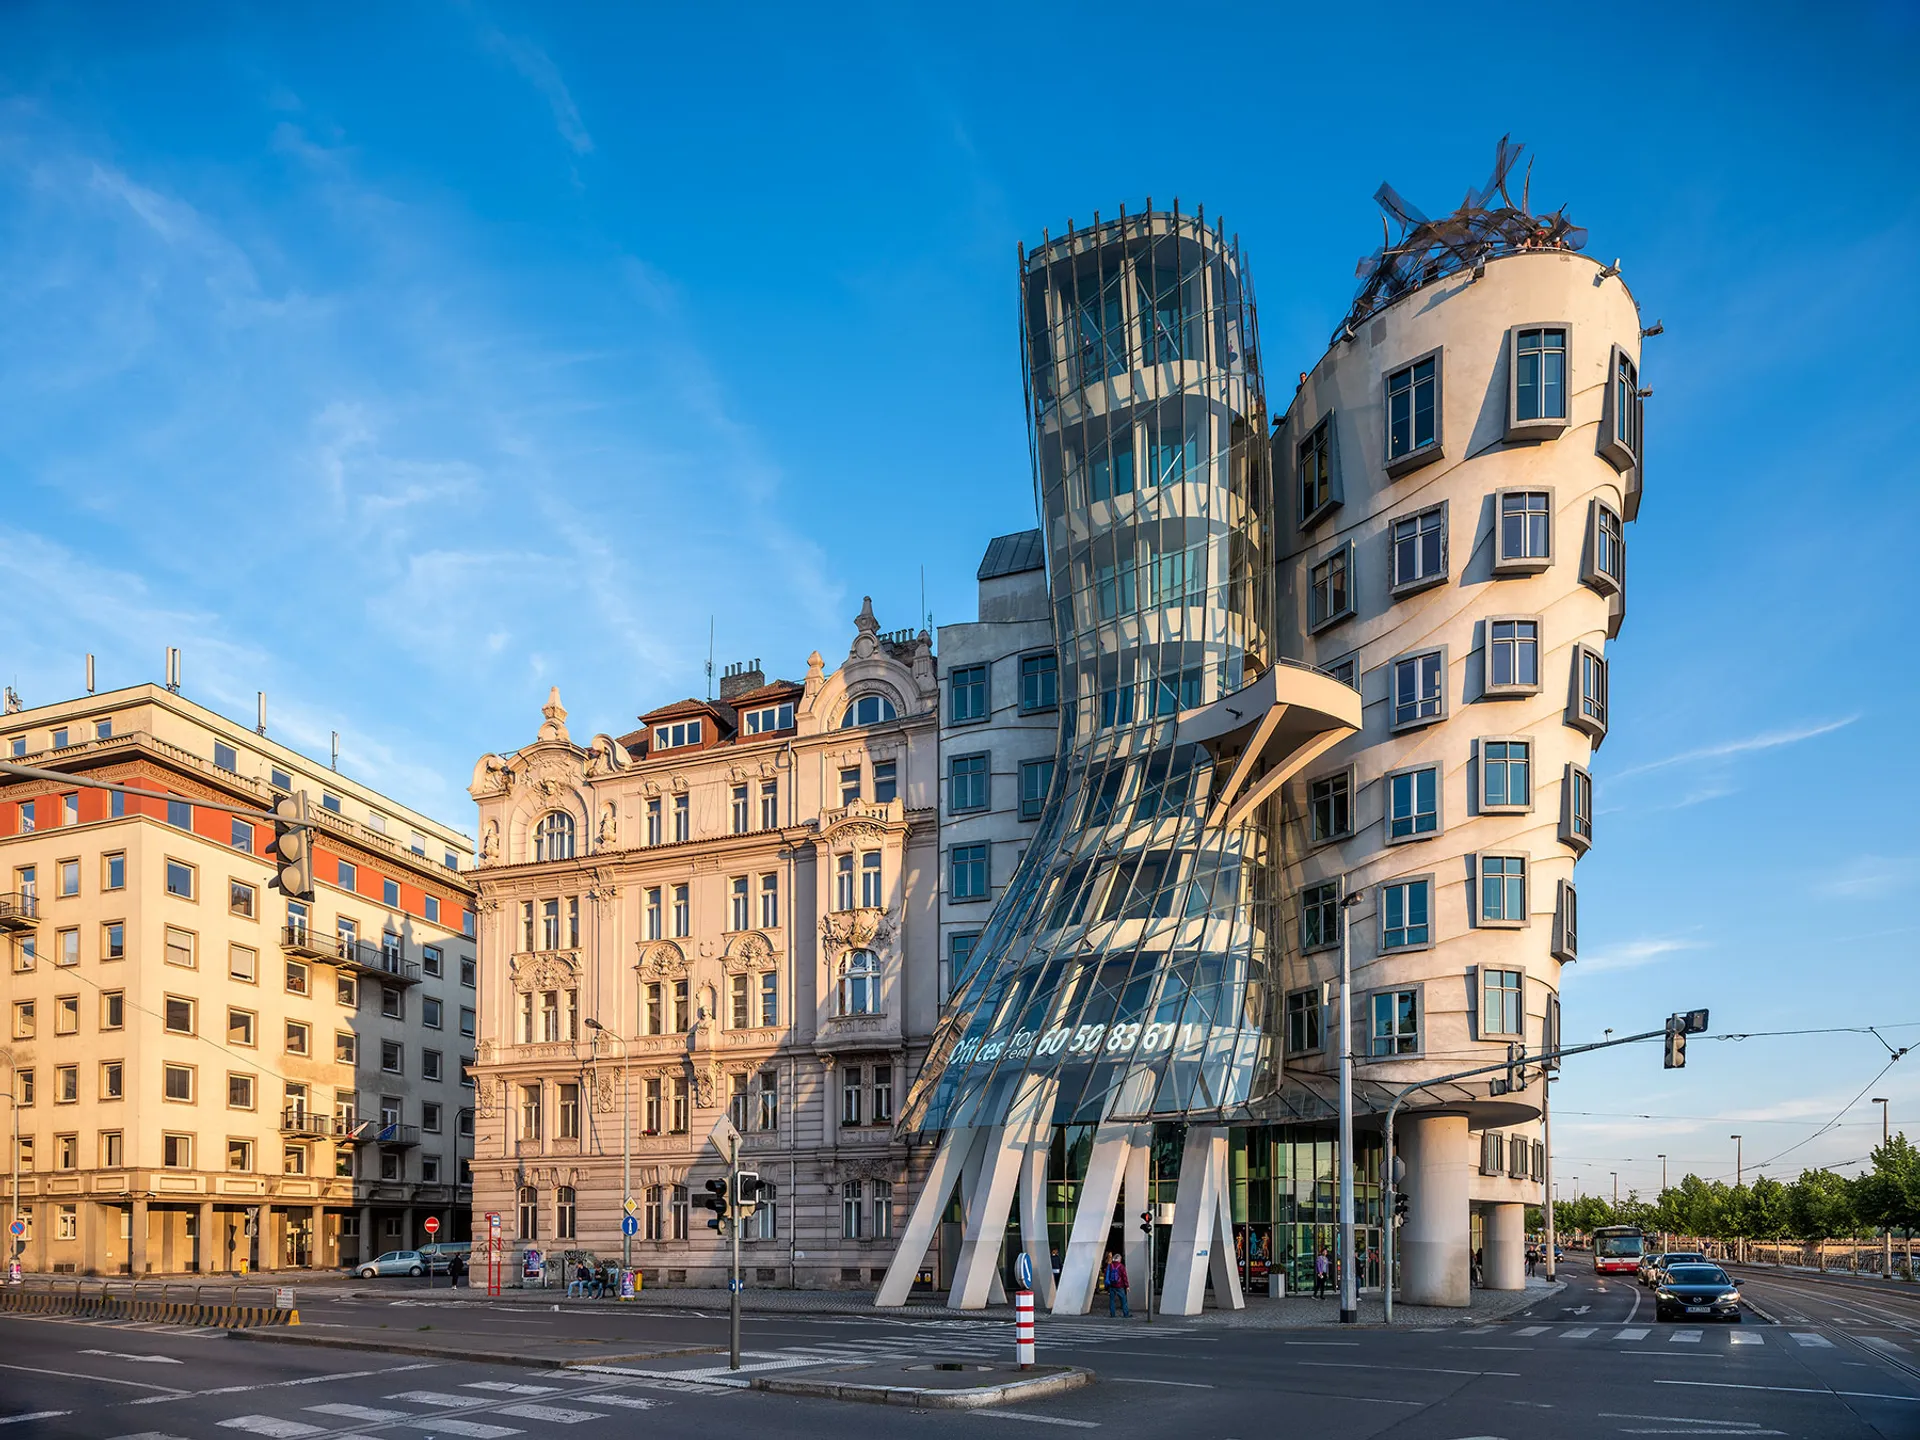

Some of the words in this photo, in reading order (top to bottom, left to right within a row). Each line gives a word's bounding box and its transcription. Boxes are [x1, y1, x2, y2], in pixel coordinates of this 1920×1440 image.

[949, 1036, 1005, 1065] Offices
[1010, 1026, 1036, 1048] for
[1003, 1045, 1032, 1060] rent
[1035, 1027, 1070, 1055] 60
[1107, 1022, 1140, 1051] 83
